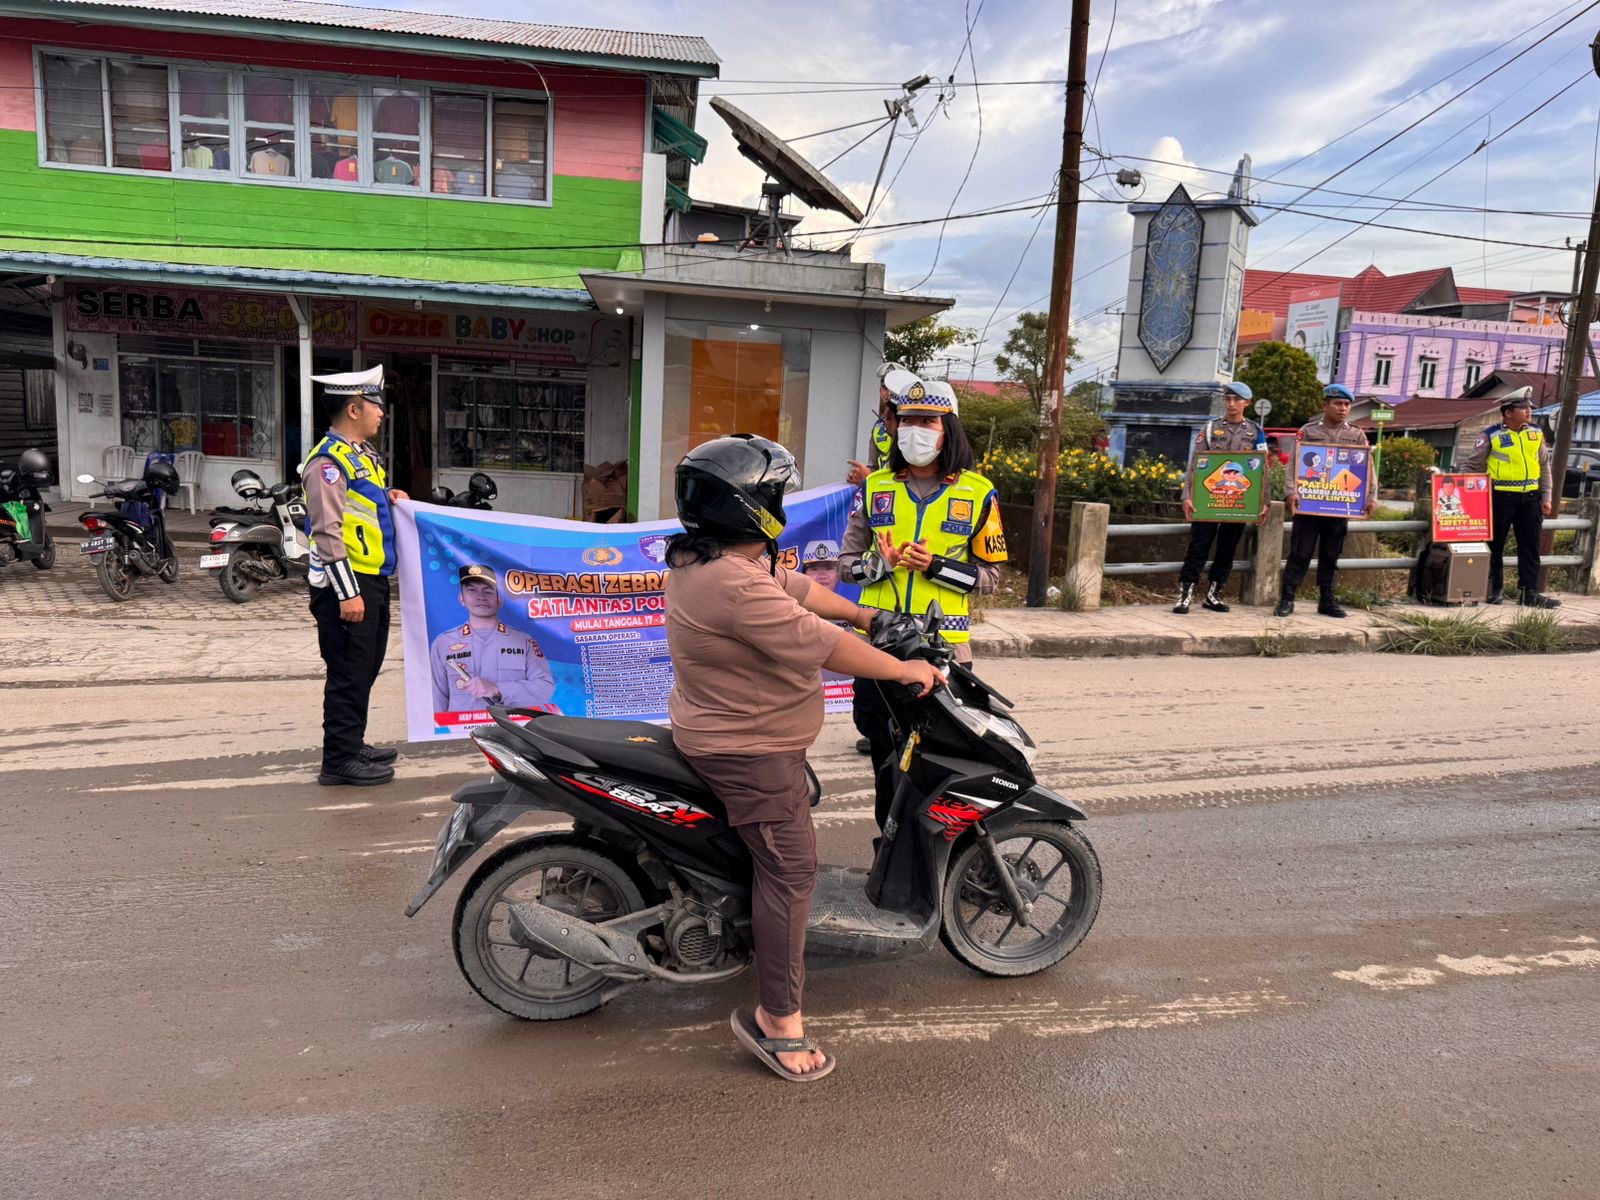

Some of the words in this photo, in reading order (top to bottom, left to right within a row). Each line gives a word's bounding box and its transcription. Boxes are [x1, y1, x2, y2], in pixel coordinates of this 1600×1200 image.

[76, 290, 204, 321] SERBA
[369, 313, 443, 337] Ozzie
[456, 315, 526, 340] BABY
[527, 326, 575, 344] SHOP
[1302, 480, 1340, 490] PATUHI
[1302, 492, 1324, 500] LALU
[1326, 494, 1357, 503] LINTAS
[1331, 489, 1361, 497] RAMBU
[508, 571, 600, 593] OPERASI
[529, 598, 632, 617] SATLANTAS
[575, 618, 602, 630] MULAI
[604, 616, 642, 628] TANGGAL
[644, 615, 653, 625] 17
[575, 634, 607, 643] SASARAN
[608, 632, 636, 640] OPERASI
[500, 647, 525, 655] POLRI
[991, 776, 1019, 790] HONDA
